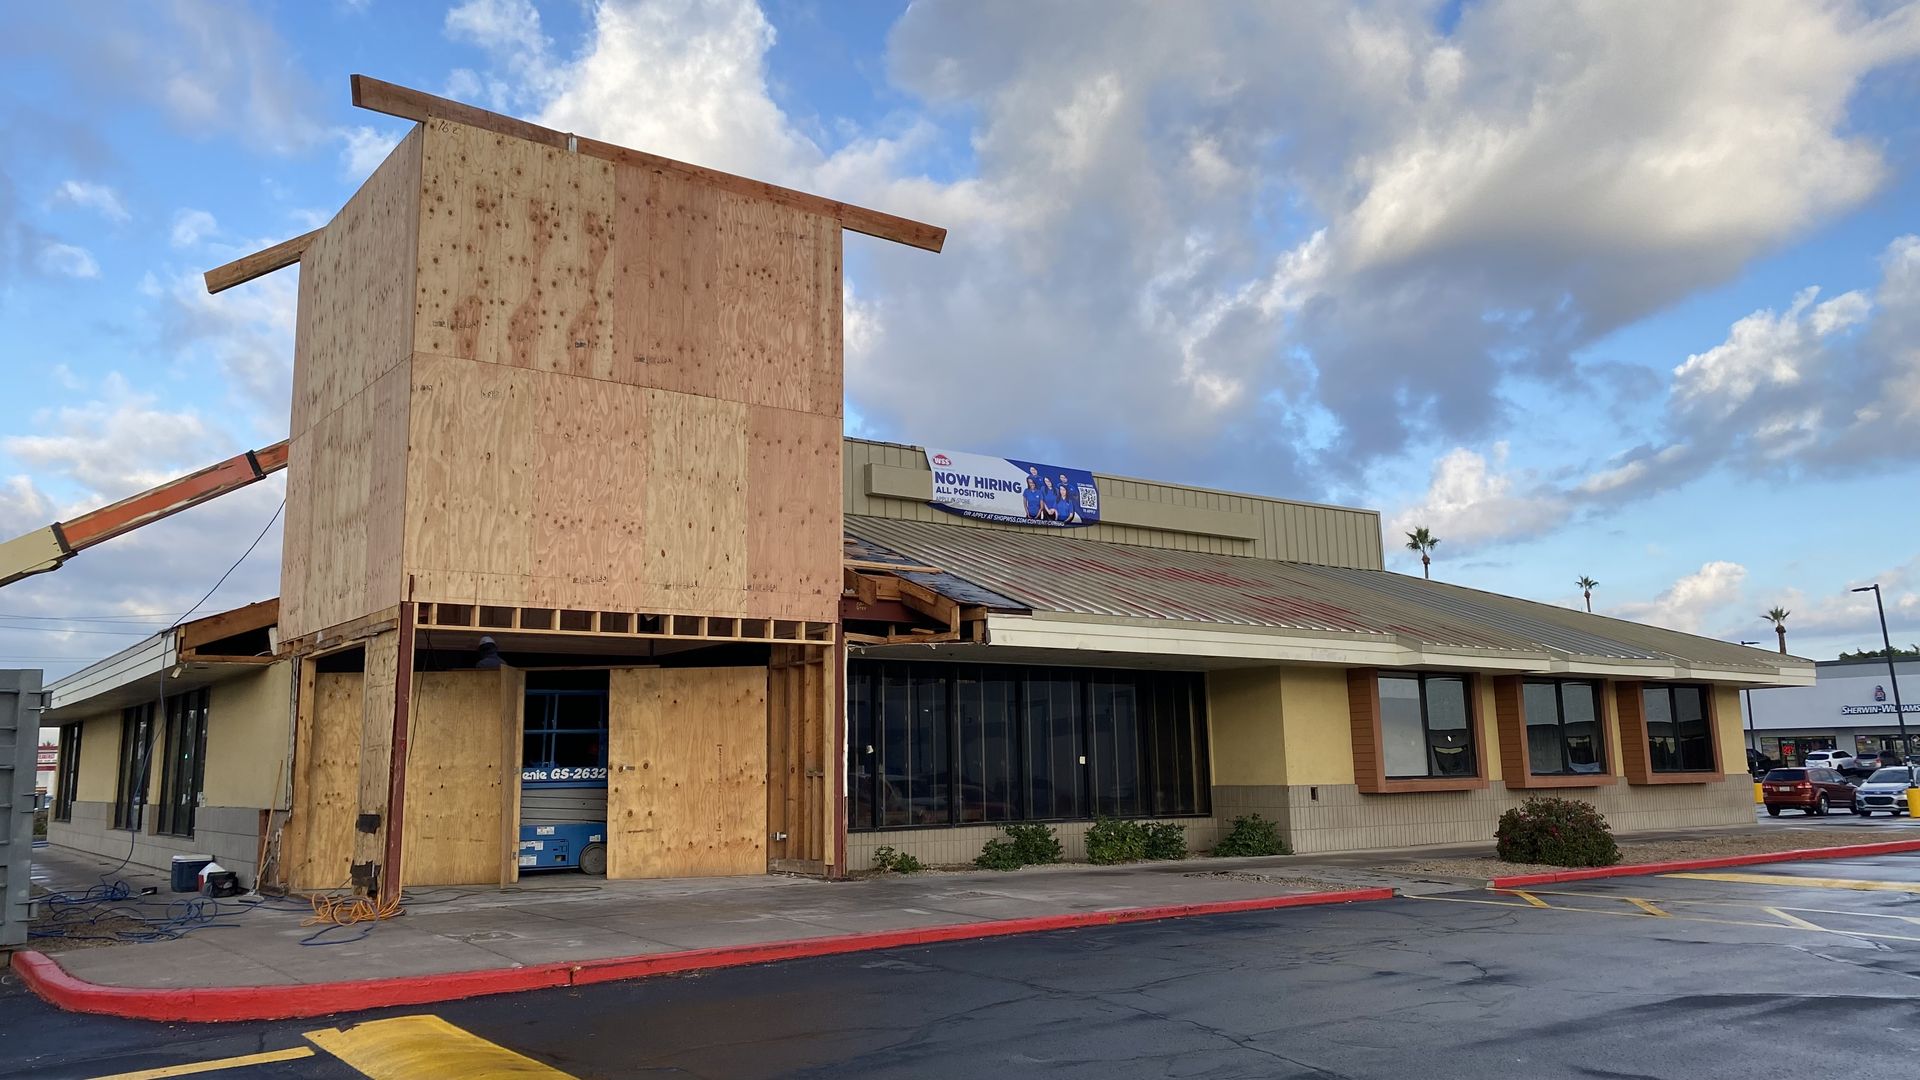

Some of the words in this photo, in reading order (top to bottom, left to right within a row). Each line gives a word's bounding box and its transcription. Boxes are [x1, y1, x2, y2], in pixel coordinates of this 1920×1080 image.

[934, 457, 951, 466] WSS
[935, 471, 970, 487] NOW
[974, 476, 1022, 493] HIRING
[936, 486, 952, 495] ALL
[953, 488, 995, 500] POSITIONS
[972, 511, 987, 519] APPLY
[1841, 704, 1920, 714] SHERWIN-WILIAMS
[522, 769, 547, 779] enie
[551, 768, 607, 779] GS-2632
